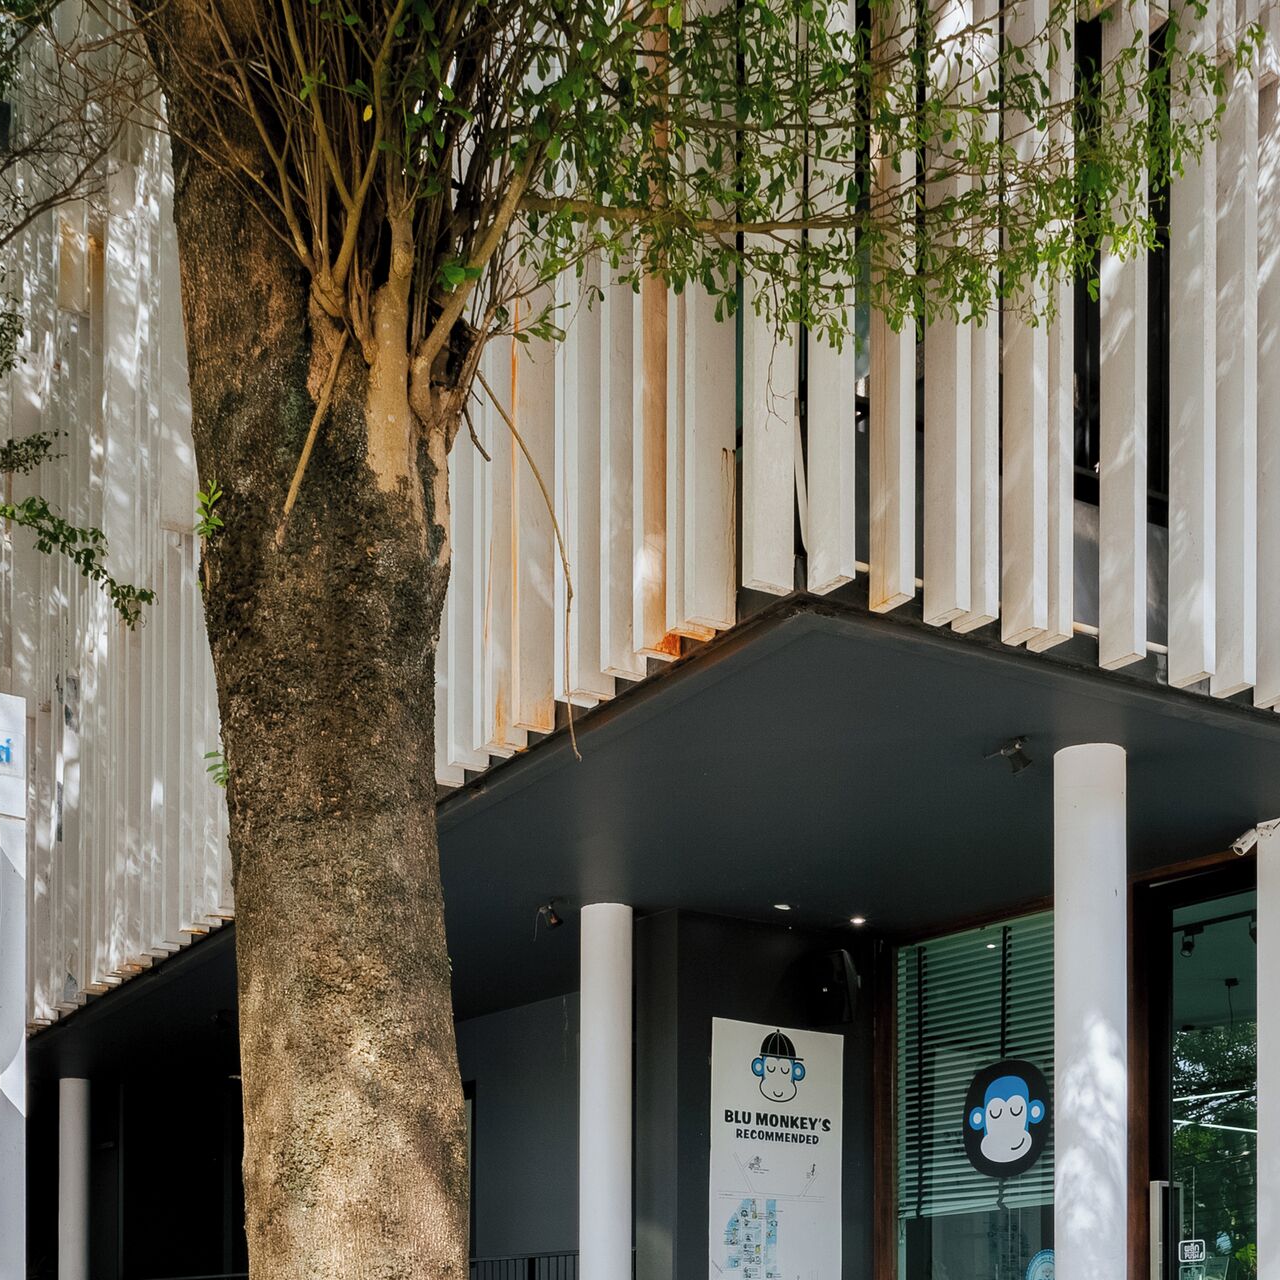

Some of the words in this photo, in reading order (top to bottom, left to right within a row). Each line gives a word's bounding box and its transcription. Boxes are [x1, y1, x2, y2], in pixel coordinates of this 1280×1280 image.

[724, 1109, 752, 1125] BLU
[756, 1111, 832, 1132] MONKEY'S
[735, 1128, 820, 1146] RECOMMENDED
